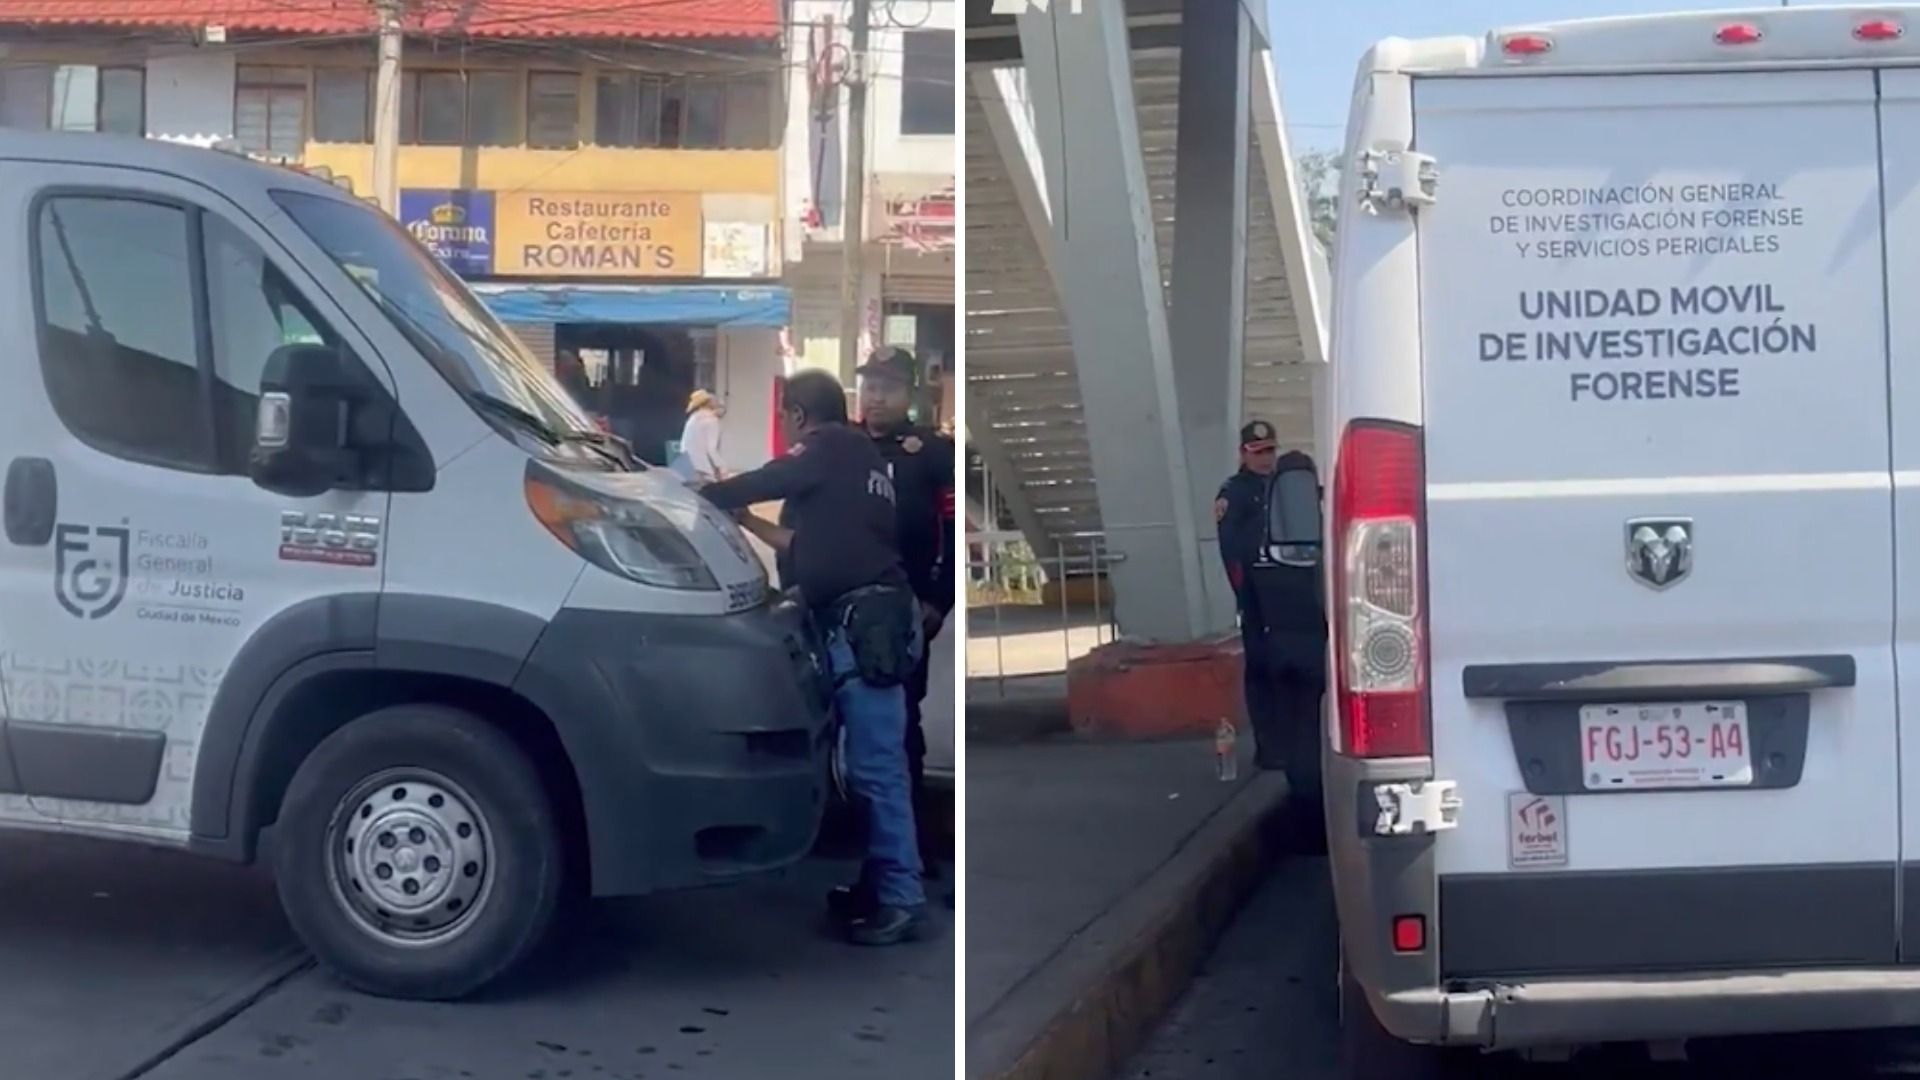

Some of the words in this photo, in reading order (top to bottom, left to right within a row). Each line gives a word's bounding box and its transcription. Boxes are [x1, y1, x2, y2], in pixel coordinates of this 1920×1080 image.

[1502, 182, 1674, 207] COORDINACIÓN
[1680, 183, 1784, 202] GENERAL
[529, 198, 671, 217] Restaurante
[1490, 215, 1519, 233] DE
[1525, 208, 1696, 233] INVESTIGACIÓN
[1702, 208, 1804, 228] FORENSE
[1516, 242, 1531, 258] Y
[1537, 239, 1650, 259] SERVICIOS
[1656, 235, 1780, 256] PERICIALES
[1519, 288, 1662, 320] UNIDAD
[1671, 284, 1785, 315] MOVIL
[1479, 333, 1527, 361] DE
[1536, 318, 1817, 361] INVESTIGACIÓN
[1571, 368, 1741, 401] FORENSE
[137, 529, 208, 549] Fiscalía
[137, 553, 213, 574] General
[169, 580, 244, 601] Justicia
[136, 607, 179, 622] Ciudad
[1587, 723, 1743, 762] FGJ-53-A4
